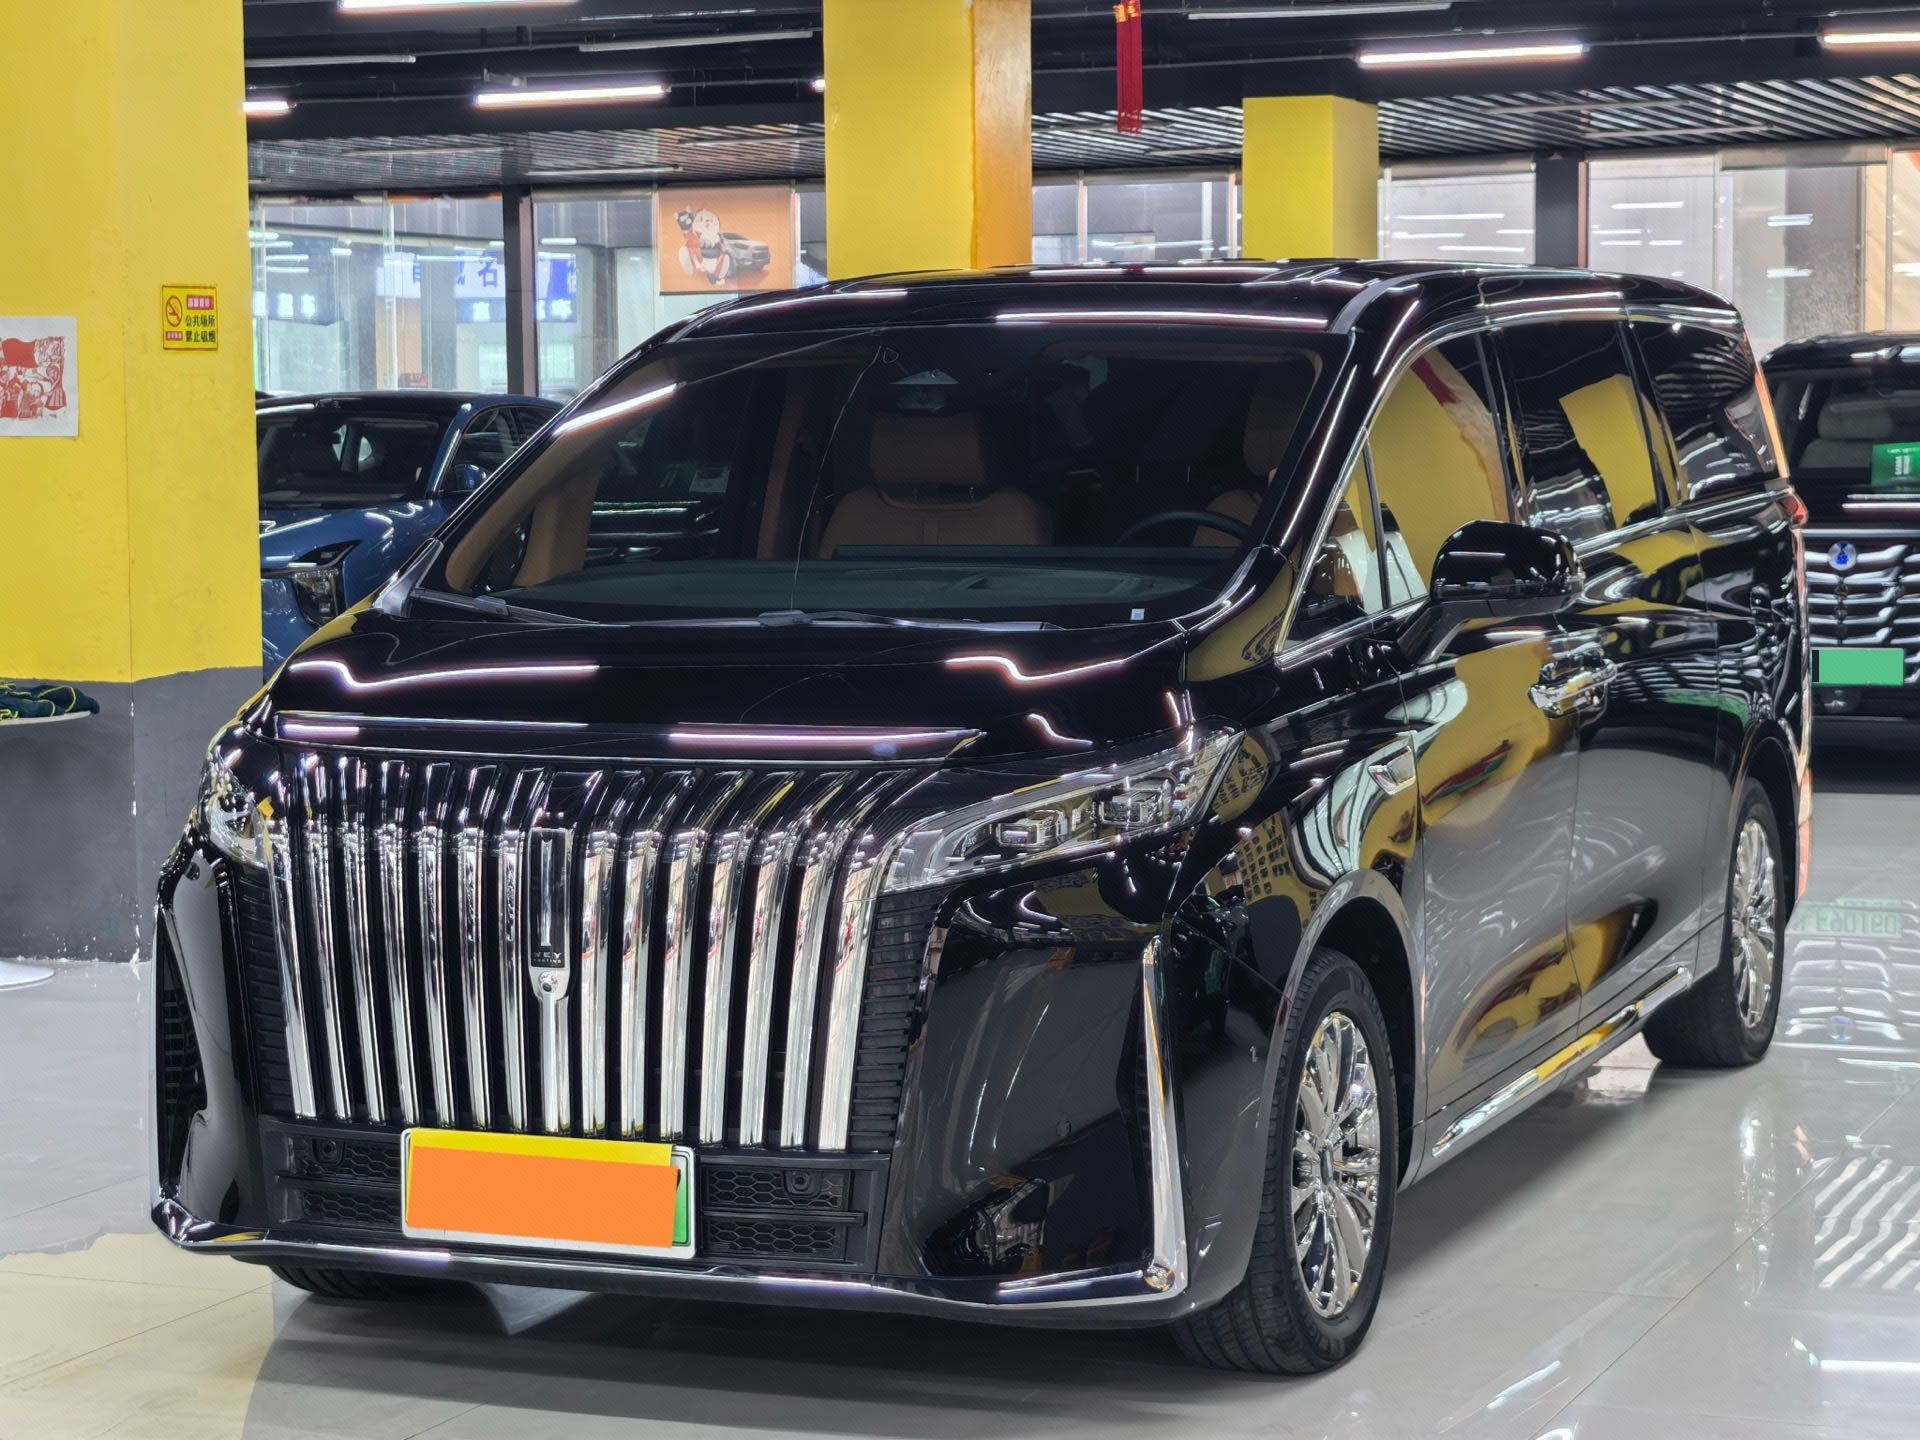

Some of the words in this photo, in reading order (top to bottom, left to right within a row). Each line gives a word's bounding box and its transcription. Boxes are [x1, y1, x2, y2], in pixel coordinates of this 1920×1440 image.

[186, 314, 216, 327] 公共场所
[186, 330, 216, 343] 禁止吸烟
